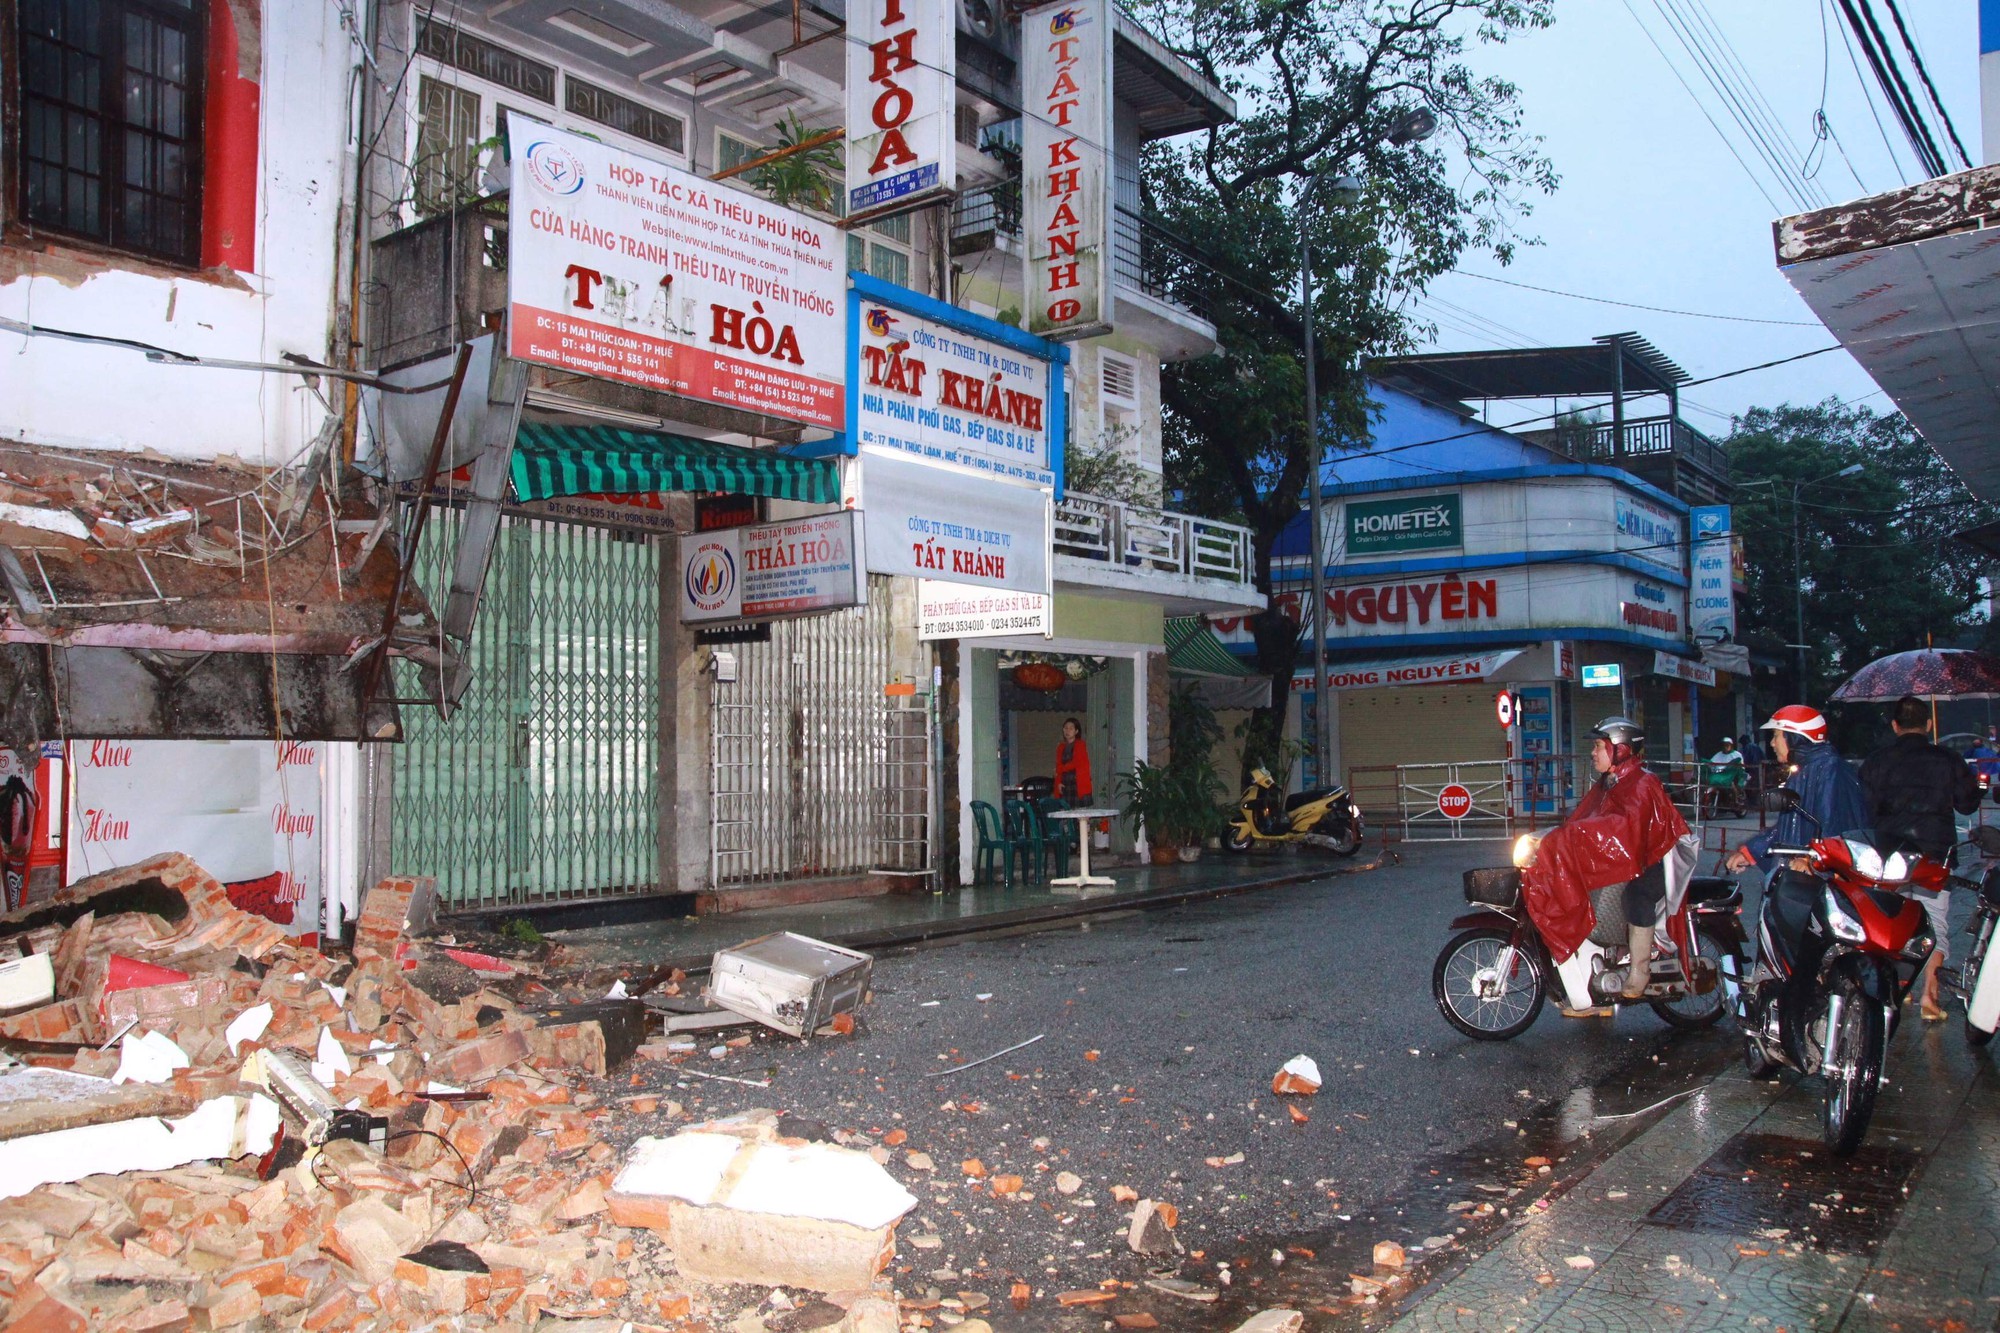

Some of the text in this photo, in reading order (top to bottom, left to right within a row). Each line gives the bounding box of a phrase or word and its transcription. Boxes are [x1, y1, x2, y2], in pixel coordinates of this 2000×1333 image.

[1046, 36, 1080, 127] TẤT
[868, 28, 918, 175] HÒA
[609, 163, 645, 188] HỢP
[650, 177, 682, 201] TÁC
[688, 189, 709, 210] XÃ
[714, 198, 753, 225] THÊU
[758, 214, 786, 237] PHÚ
[792, 226, 821, 250] HÒA
[1046, 136, 1080, 292] KHÁNH
[596, 184, 629, 203] THÀNH
[631, 195, 653, 212] VIÊN
[655, 204, 675, 218] LIÊN
[677, 210, 700, 227] MINH
[702, 220, 718, 234] HỢP
[721, 225, 736, 239] TÁC
[794, 250, 816, 266] THIÊN
[818, 258, 834, 272] HUẾ
[530, 206, 564, 236] CỬA
[570, 219, 616, 250] HÀNG
[620, 234, 668, 267] TRANH
[673, 251, 709, 278] THÊU
[712, 264, 736, 287] TAY
[793, 290, 834, 317] THỐNG
[1054, 302, 1073, 319] 17
[557, 322, 567, 333] 15
[570, 325, 588, 339] MAI
[642, 342, 652, 353] TP
[654, 345, 673, 358] HUẾ
[710, 301, 804, 365] HÒA
[530, 344, 560, 360] Email:
[562, 338, 659, 370] ĐT: +84 (54) 3 535 141
[914, 329, 936, 349] CÔNG
[938, 338, 950, 353] TY
[952, 343, 976, 362] TNHH
[978, 351, 990, 366] TM
[993, 356, 999, 369] &
[1001, 358, 1020, 376] DỊCH
[1023, 366, 1034, 383] VỤ
[713, 387, 736, 401] Email:
[730, 365, 742, 376] 130
[745, 369, 766, 381] PHAN
[810, 384, 818, 394] TP
[819, 387, 835, 398] HUẾ
[735, 379, 748, 390] ĐT:
[749, 383, 763, 394] +84
[765, 387, 780, 399] (54)
[782, 390, 786, 399] 3
[861, 340, 1042, 432] TẤT KHÁNH
[863, 394, 884, 415] NHÀ
[888, 400, 914, 423] PHÂN
[918, 408, 940, 429] PHỐI
[968, 420, 984, 440] BẾP
[987, 427, 1004, 446] GAS
[1017, 436, 1023, 450] &
[888, 437, 902, 449] MAI
[905, 440, 922, 454] THÚC
[945, 450, 958, 462] HUẾ
[770, 529, 782, 538] TAY
[909, 516, 1011, 550] CÔNG TY TNHH TM & DỊCH VỤ
[1354, 509, 1450, 534] HOMETEX
[744, 533, 846, 572] THÁI HÒA
[913, 536, 1005, 579] TẤT KHÁNH
[1700, 556, 1722, 573] NỆM
[1324, 572, 1497, 626] NGUYÊN
[1702, 578, 1722, 589] KIM
[924, 602, 943, 617] PHÂN
[945, 597, 960, 616] PHỐI
[980, 596, 993, 613] BẾP
[995, 598, 1010, 612] GAS
[1695, 598, 1729, 609] CƯƠNG
[938, 622, 954, 634] 0234
[956, 620, 984, 632] 3534010
[991, 618, 1009, 630] 0234
[1010, 615, 1041, 628] 3524475
[1387, 661, 1480, 683] NGUYÊN
[1441, 796, 1468, 807] STOP
[84, 808, 129, 843] Hôm
[271, 803, 315, 839] Ngày
